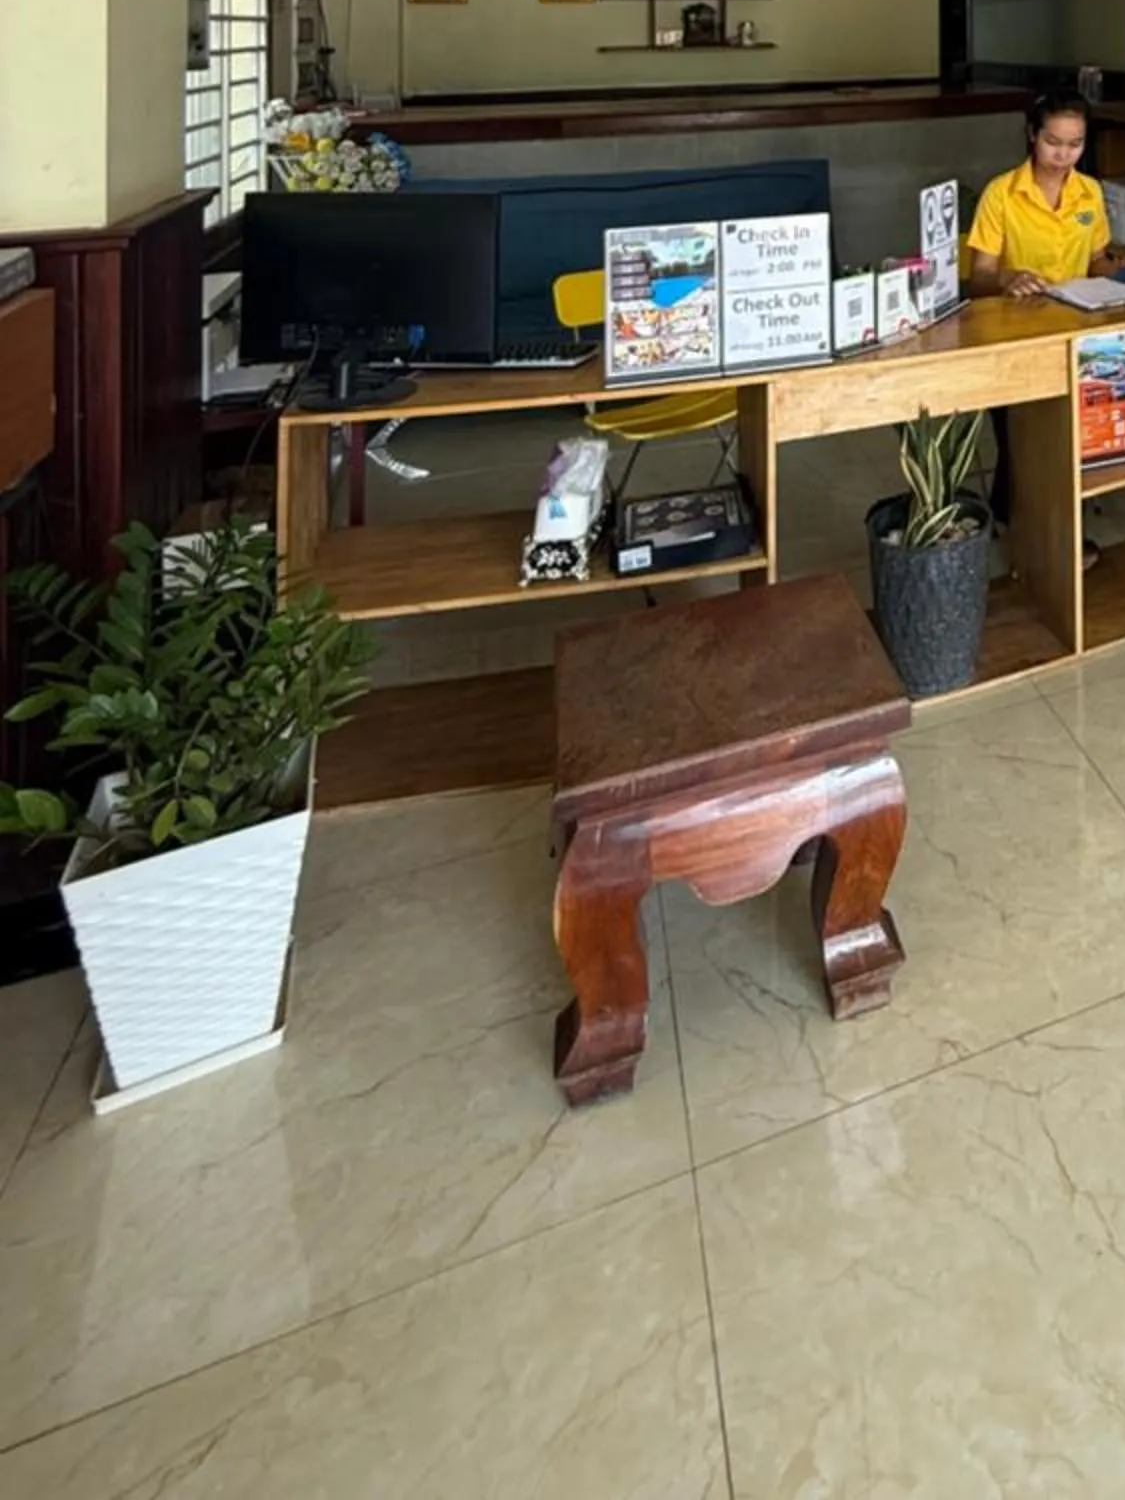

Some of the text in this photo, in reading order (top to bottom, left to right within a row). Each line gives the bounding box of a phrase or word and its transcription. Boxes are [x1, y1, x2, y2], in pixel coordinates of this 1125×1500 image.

[737, 225, 811, 244] Check In
[757, 243, 799, 258] Time
[732, 291, 820, 314] Check Out
[757, 313, 801, 329] Time
